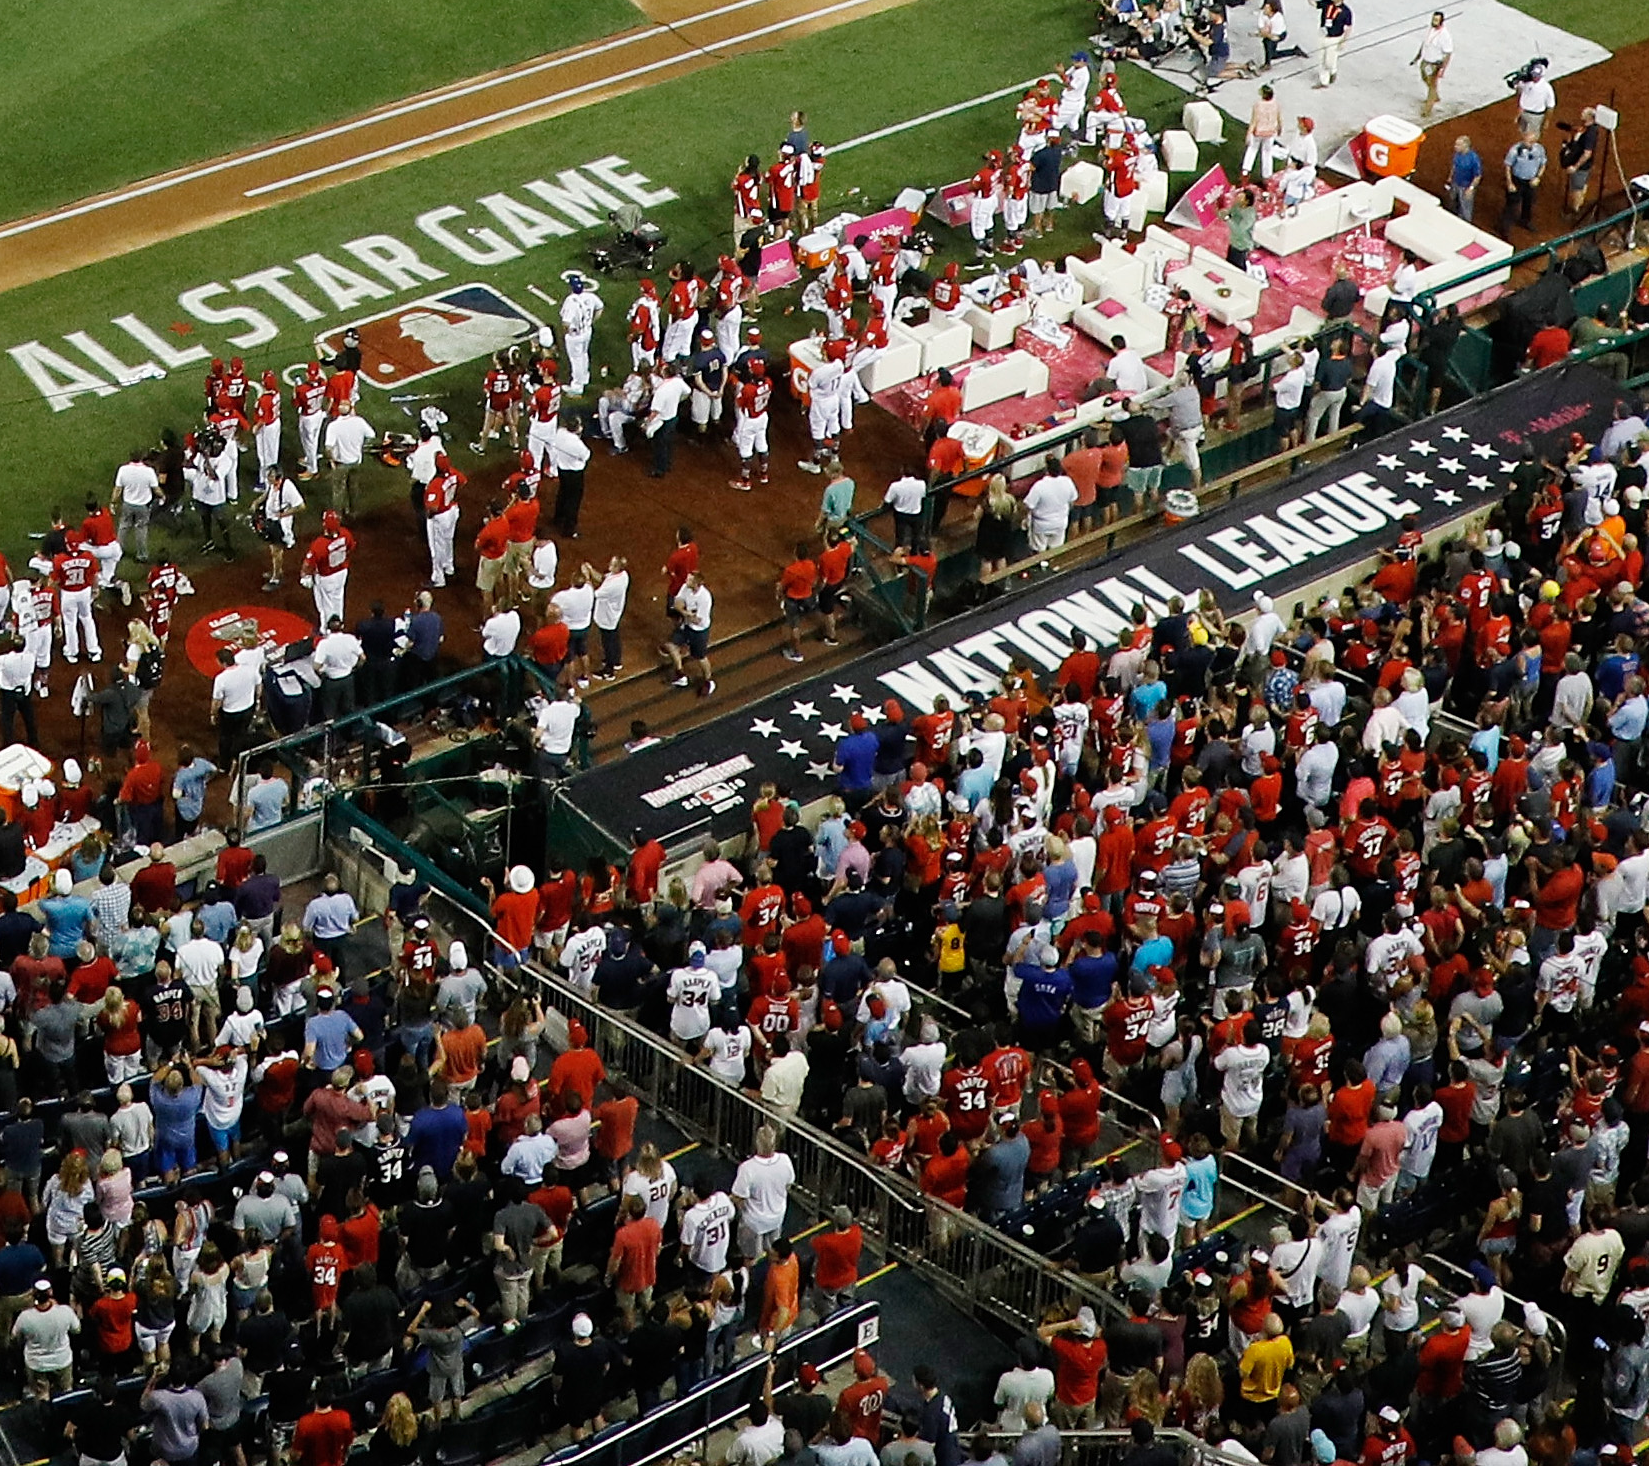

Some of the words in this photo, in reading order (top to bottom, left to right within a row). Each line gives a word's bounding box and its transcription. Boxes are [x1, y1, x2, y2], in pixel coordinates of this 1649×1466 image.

[6, 311, 213, 414] ALL
[177, 232, 450, 351] STAR
[414, 153, 682, 267] GAME
[876, 562, 1203, 715] NATIONAL
[1177, 469, 1422, 593] LEAGUE
[682, 988, 709, 1007] 34
[959, 1089, 987, 1111] 34
